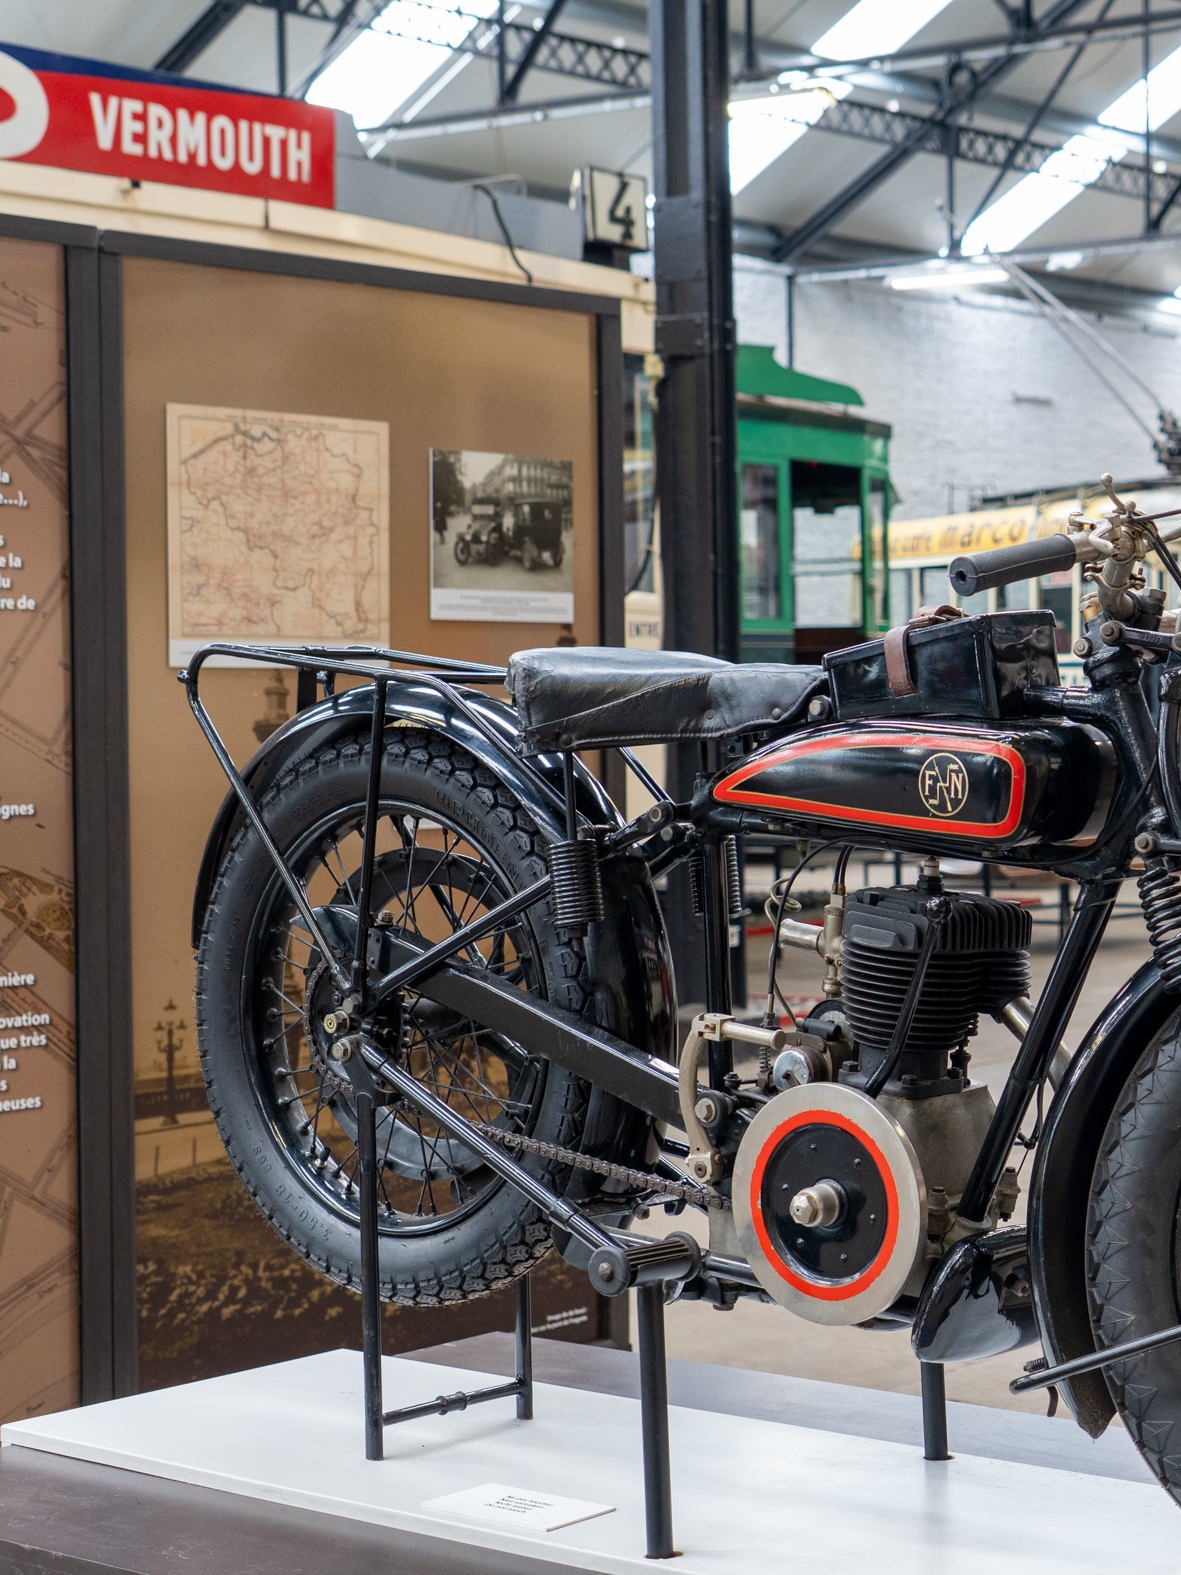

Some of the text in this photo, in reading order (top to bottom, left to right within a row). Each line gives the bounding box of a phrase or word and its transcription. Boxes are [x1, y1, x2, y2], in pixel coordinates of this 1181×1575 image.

[89, 91, 311, 183] VERMOUTH
[9, 552, 23, 568] la
[17, 595, 36, 610] de
[20, 1033, 47, 1047] très
[3, 1055, 17, 1070] la
